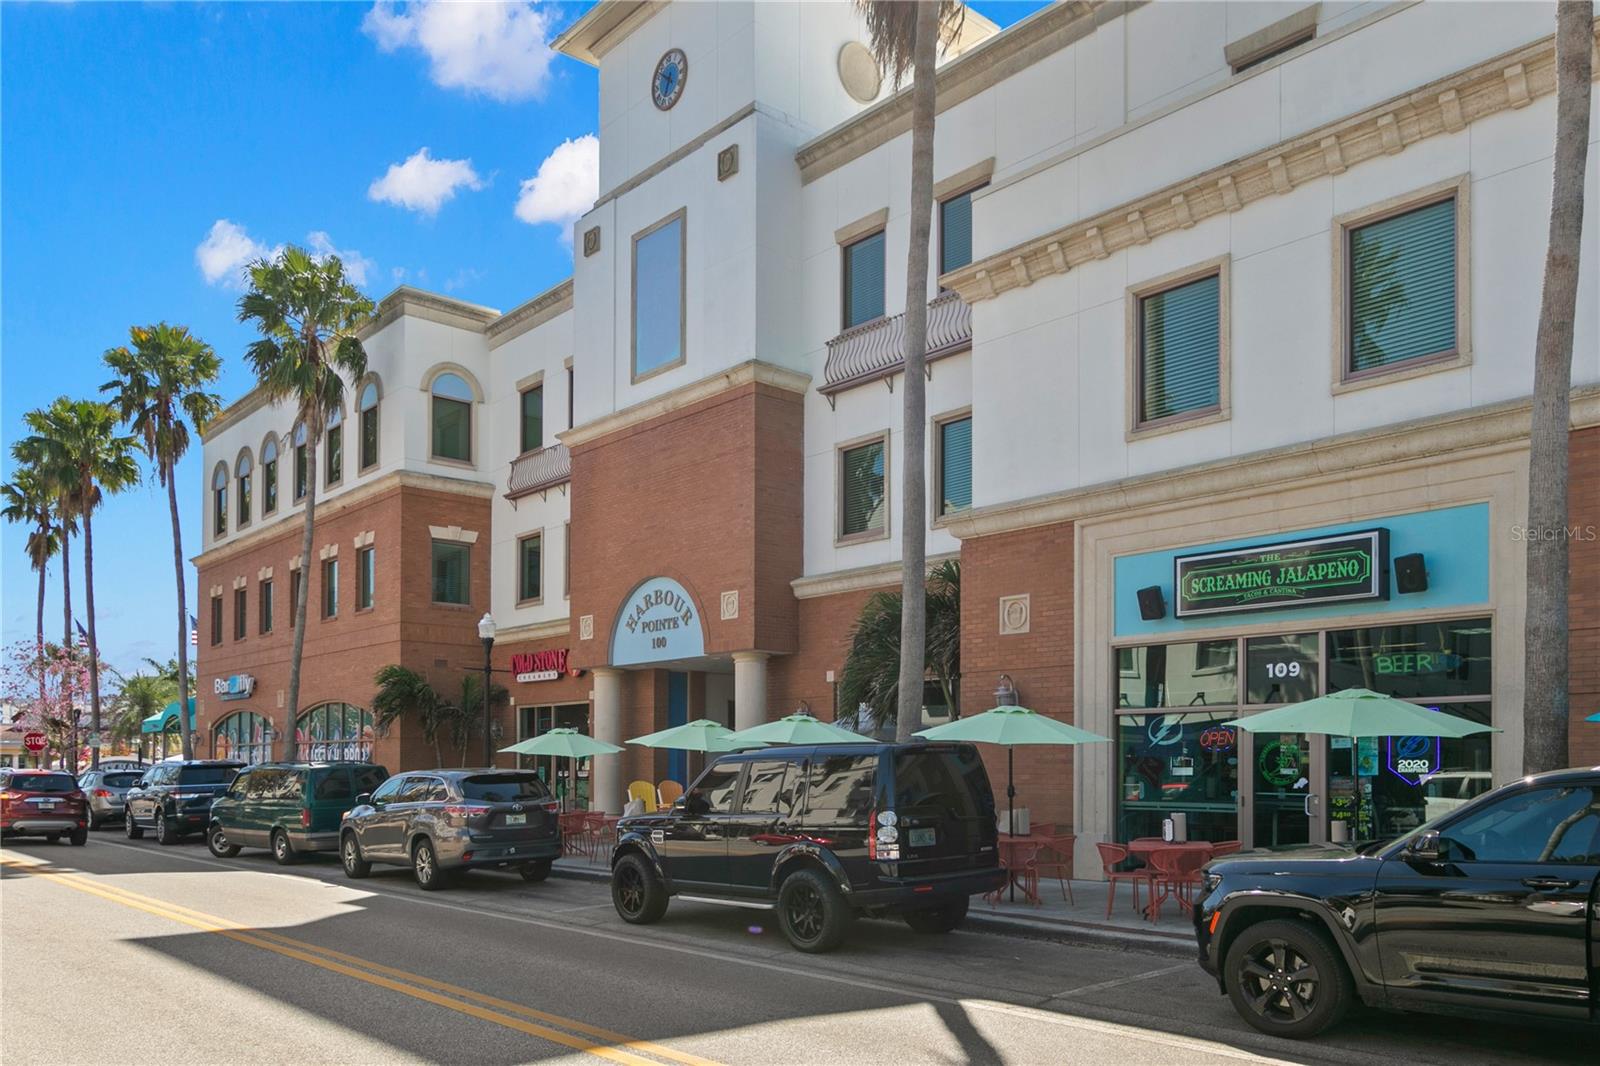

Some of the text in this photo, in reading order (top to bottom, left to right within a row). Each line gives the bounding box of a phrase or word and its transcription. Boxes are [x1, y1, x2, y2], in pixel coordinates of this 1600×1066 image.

[1260, 553, 1280, 562] THE
[1191, 558, 1359, 594] SCREAMING JALAPEÑO
[625, 589, 692, 634] HARBOUR
[641, 617, 680, 634] POINTE
[652, 637, 667, 649] 100
[534, 648, 565, 673] STONE
[1266, 662, 1301, 678] 109
[25, 736, 47, 746] STOP
[1200, 731, 1235, 746] OPEN
[1398, 760, 1429, 768] 2020
